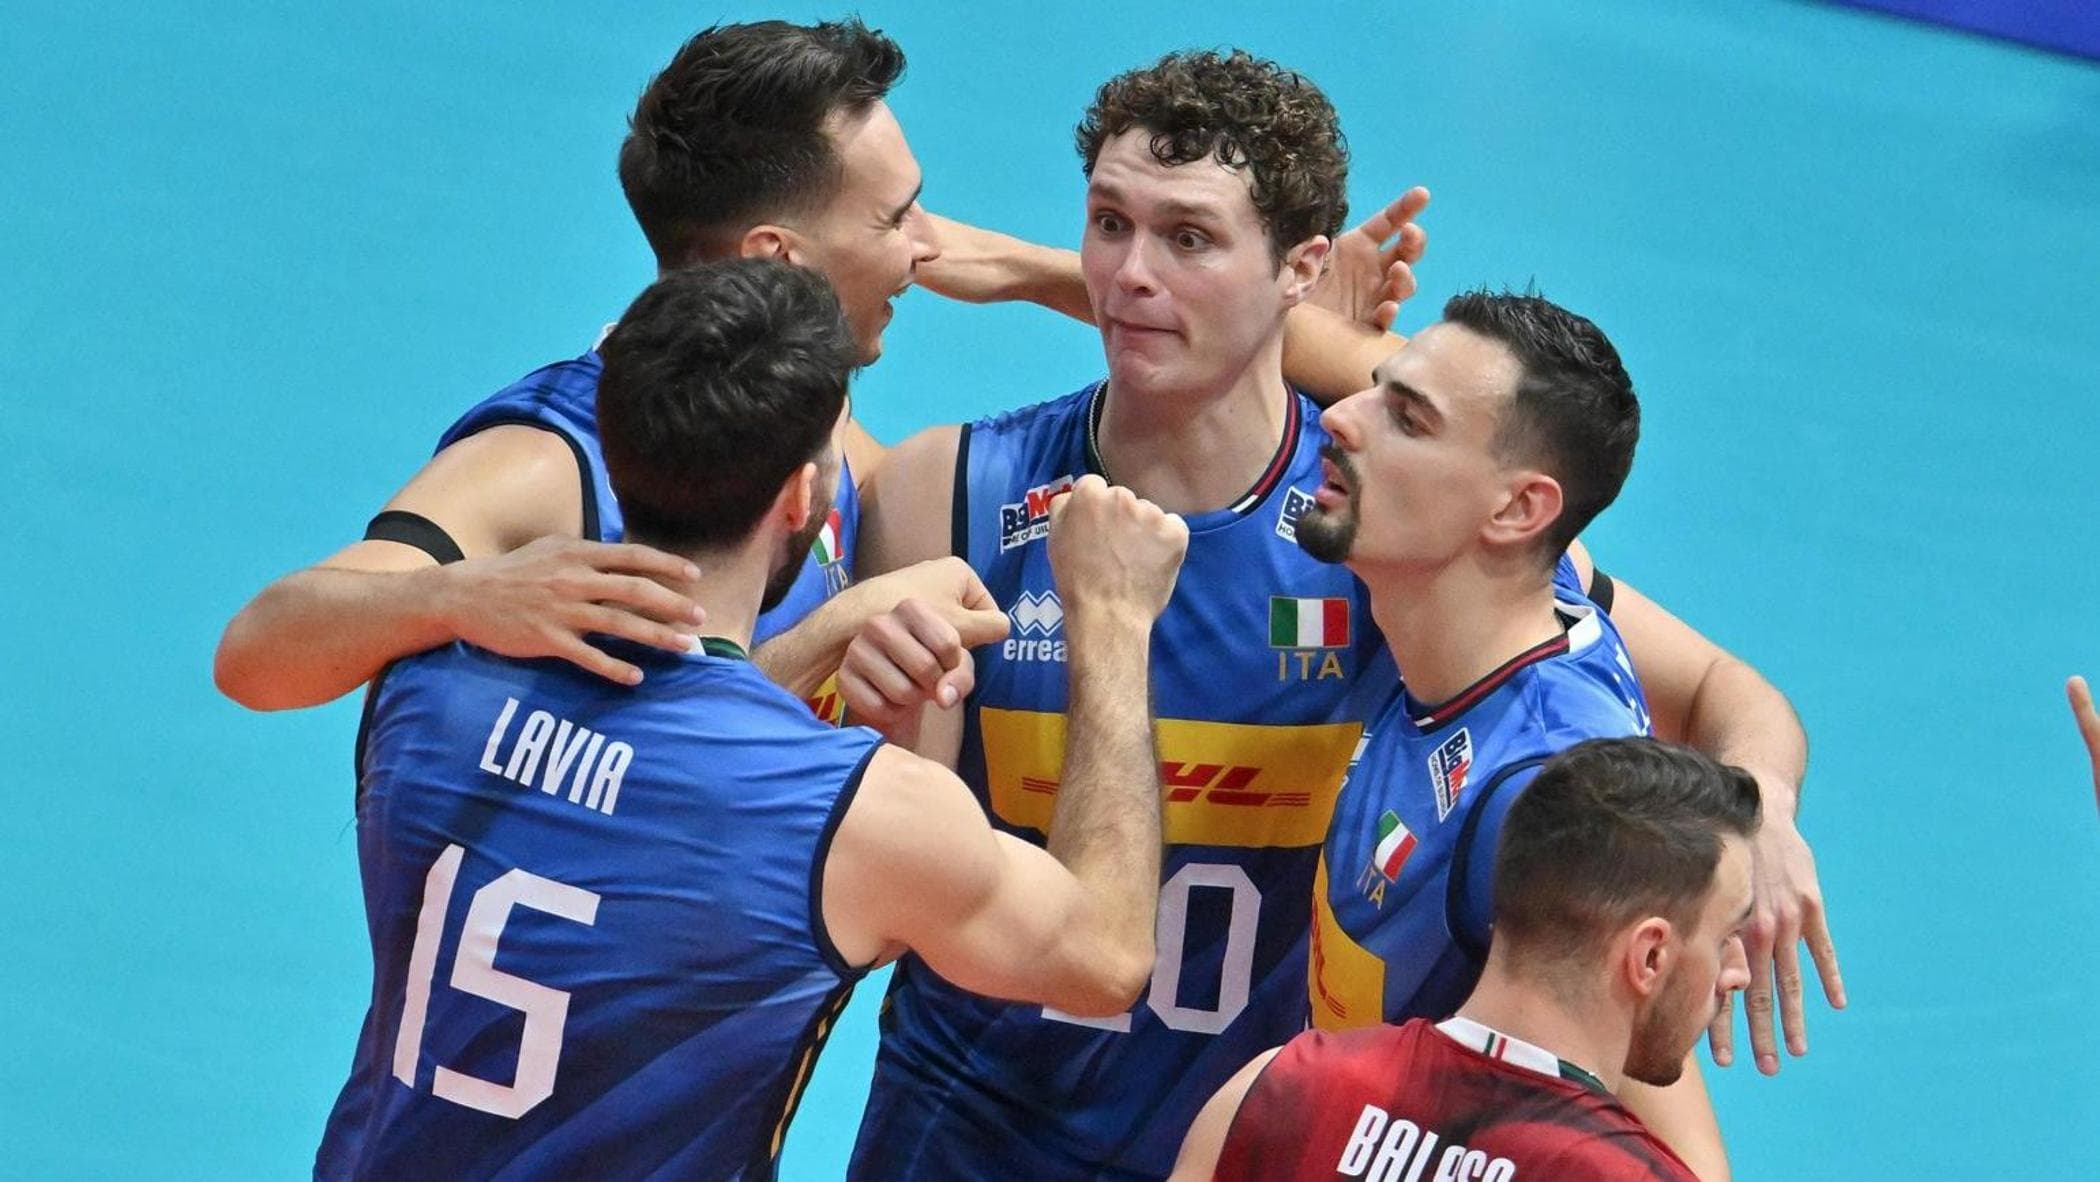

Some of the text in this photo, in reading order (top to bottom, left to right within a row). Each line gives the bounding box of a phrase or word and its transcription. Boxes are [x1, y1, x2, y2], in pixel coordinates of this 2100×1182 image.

[1278, 651, 1345, 680] ITA
[479, 697, 634, 816] LAVIA
[1160, 760, 1274, 808] HL
[1356, 860, 1386, 910] ITA
[392, 842, 601, 1119] 15
[1041, 862, 1263, 1034] 0
